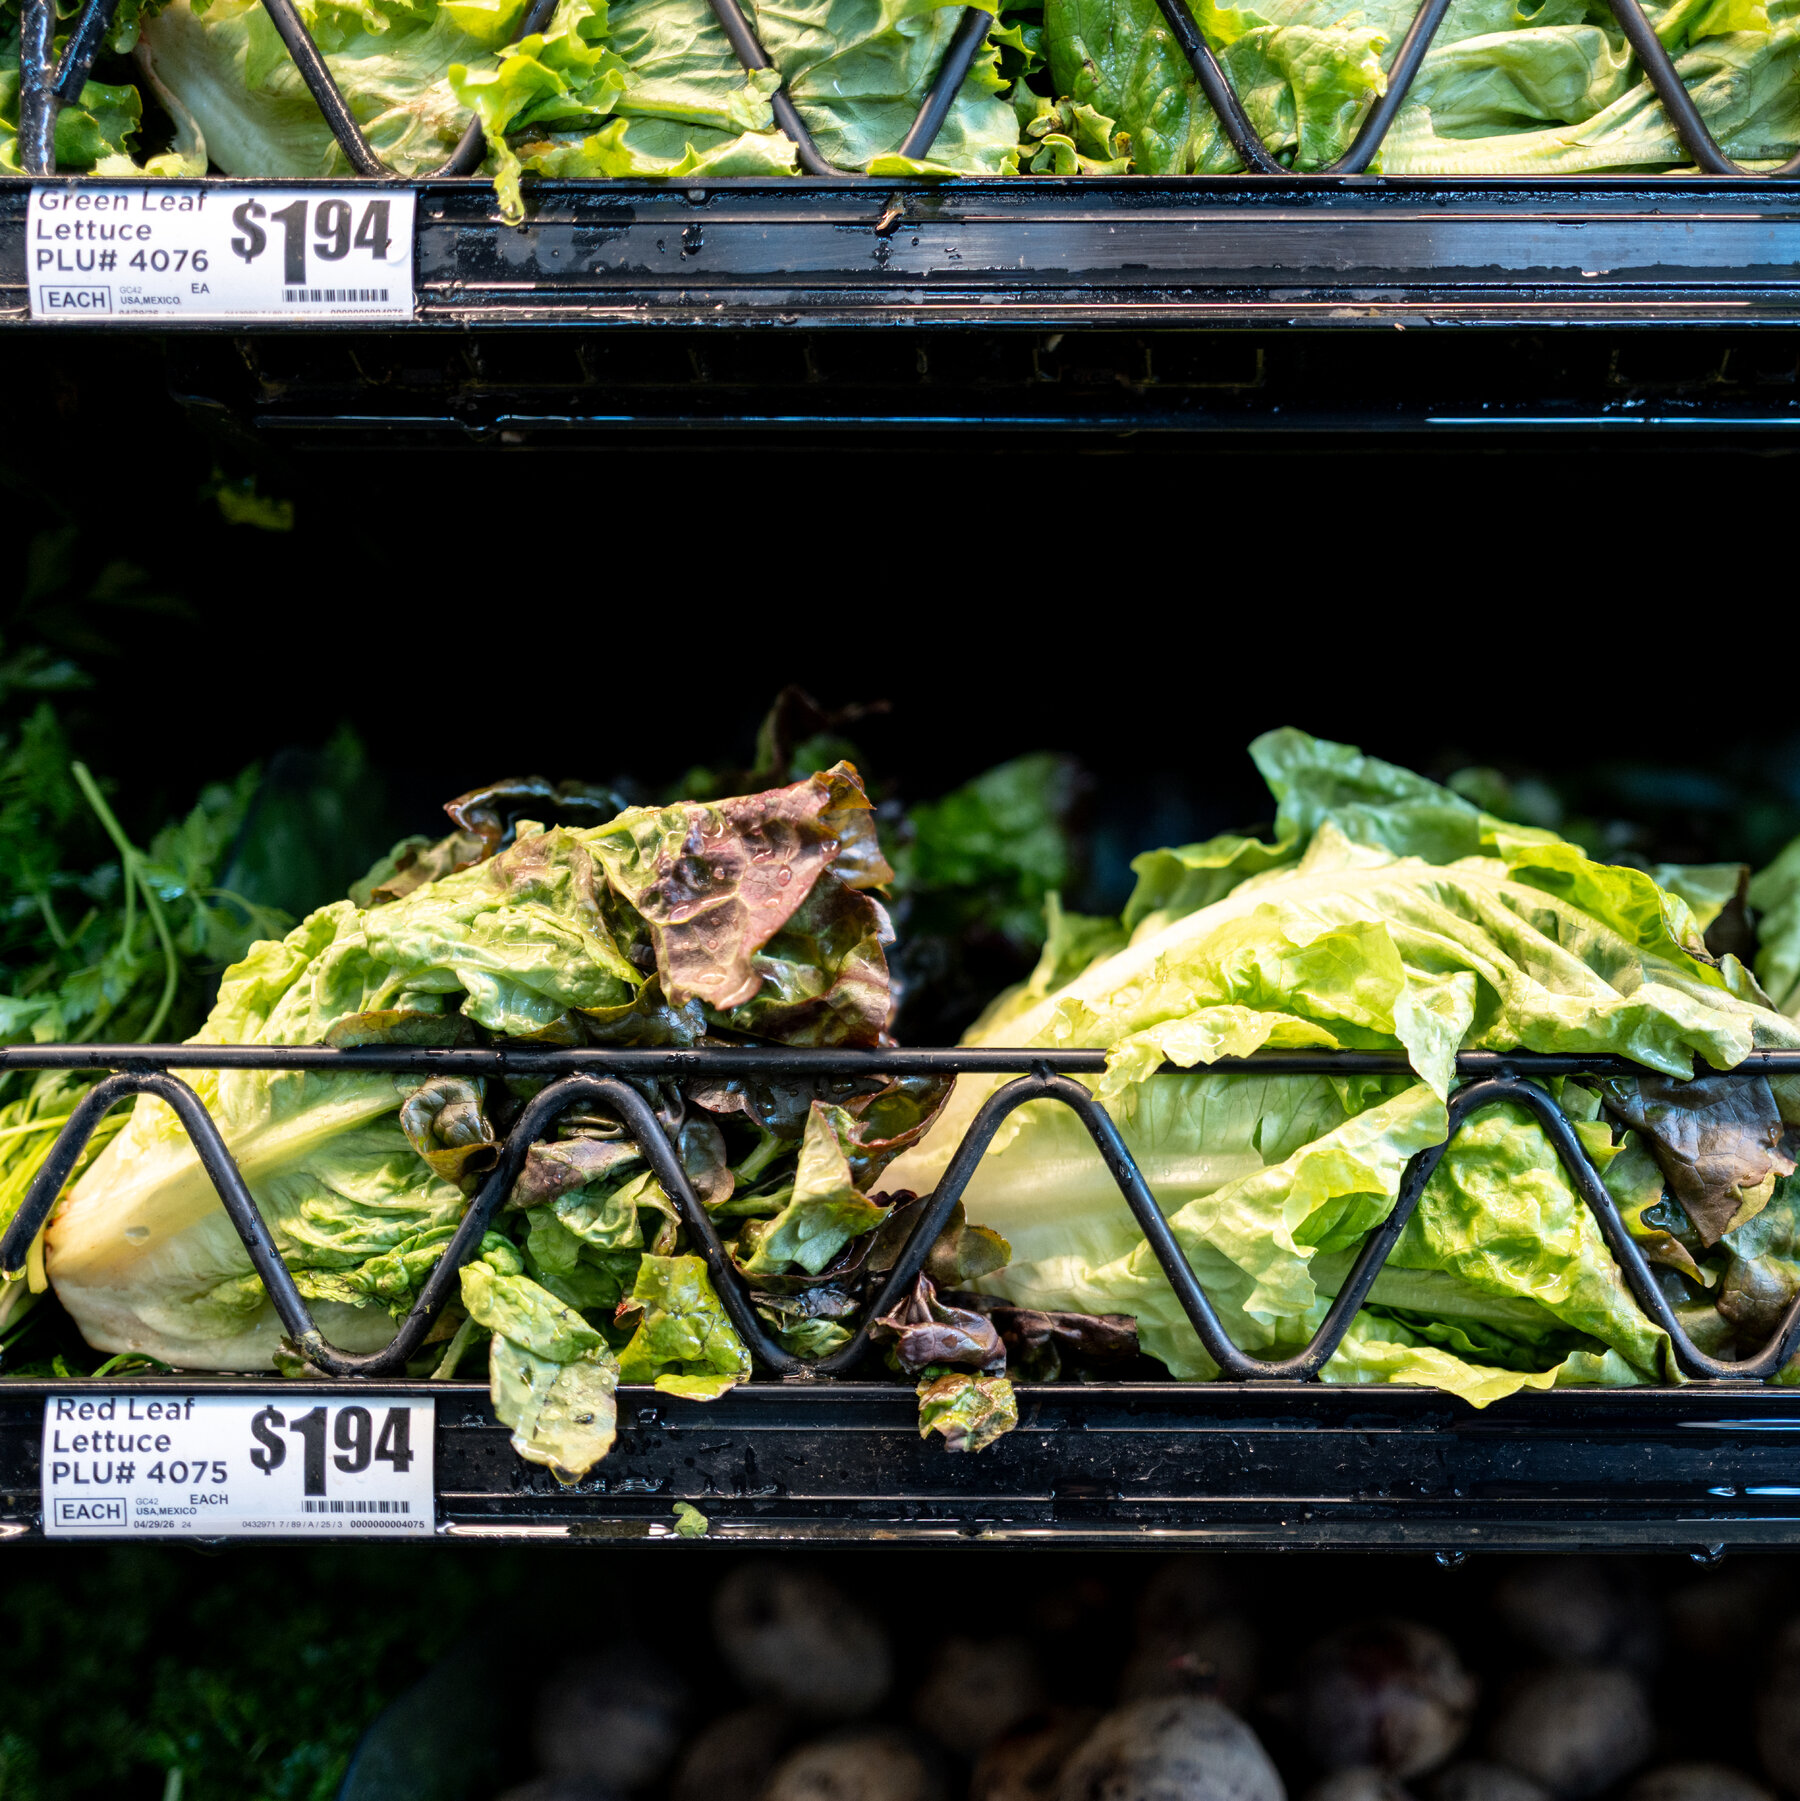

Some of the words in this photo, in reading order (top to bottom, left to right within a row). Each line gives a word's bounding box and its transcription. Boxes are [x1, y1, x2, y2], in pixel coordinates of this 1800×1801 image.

[38, 189, 129, 211] Green
[142, 189, 208, 212] Leaf
[37, 219, 152, 241] Lettuce
[231, 198, 393, 286] $194
[36, 248, 118, 272] PLU#
[129, 248, 209, 272] 4076
[191, 283, 210, 294] EA
[48, 291, 106, 308] EACH
[56, 1397, 116, 1421] Red
[128, 1397, 195, 1421] Leaf
[53, 1429, 171, 1453] Lettuce
[250, 1404, 414, 1497] $194
[52, 1461, 136, 1484] PLU#
[146, 1460, 228, 1484] 4075
[136, 1498, 159, 1506] GC42
[190, 1494, 229, 1505] EACH
[62, 1503, 121, 1520] EACH
[136, 1507, 197, 1516] USA,MEXICO
[134, 1520, 175, 1529] 04/29/26
[242, 1520, 276, 1528] 0432971
[350, 1520, 425, 1529] 0000000004075
